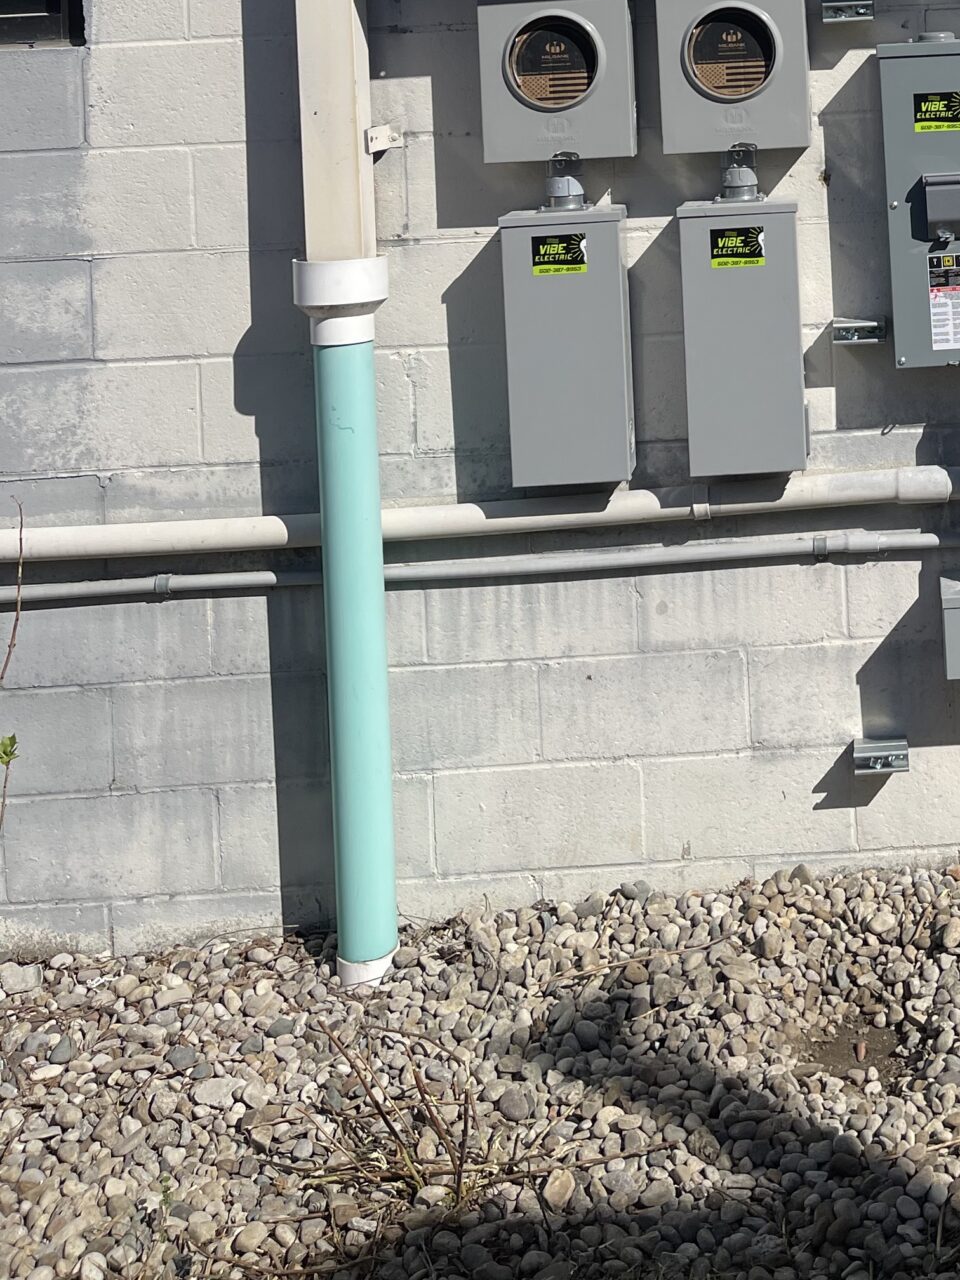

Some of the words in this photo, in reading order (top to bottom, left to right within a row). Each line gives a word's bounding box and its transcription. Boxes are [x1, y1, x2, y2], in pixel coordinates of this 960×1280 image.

[921, 101, 947, 111] VIBE
[717, 236, 745, 247] VIBE
[540, 243, 566, 254] VIBE
[713, 247, 750, 255] ELECTRIC
